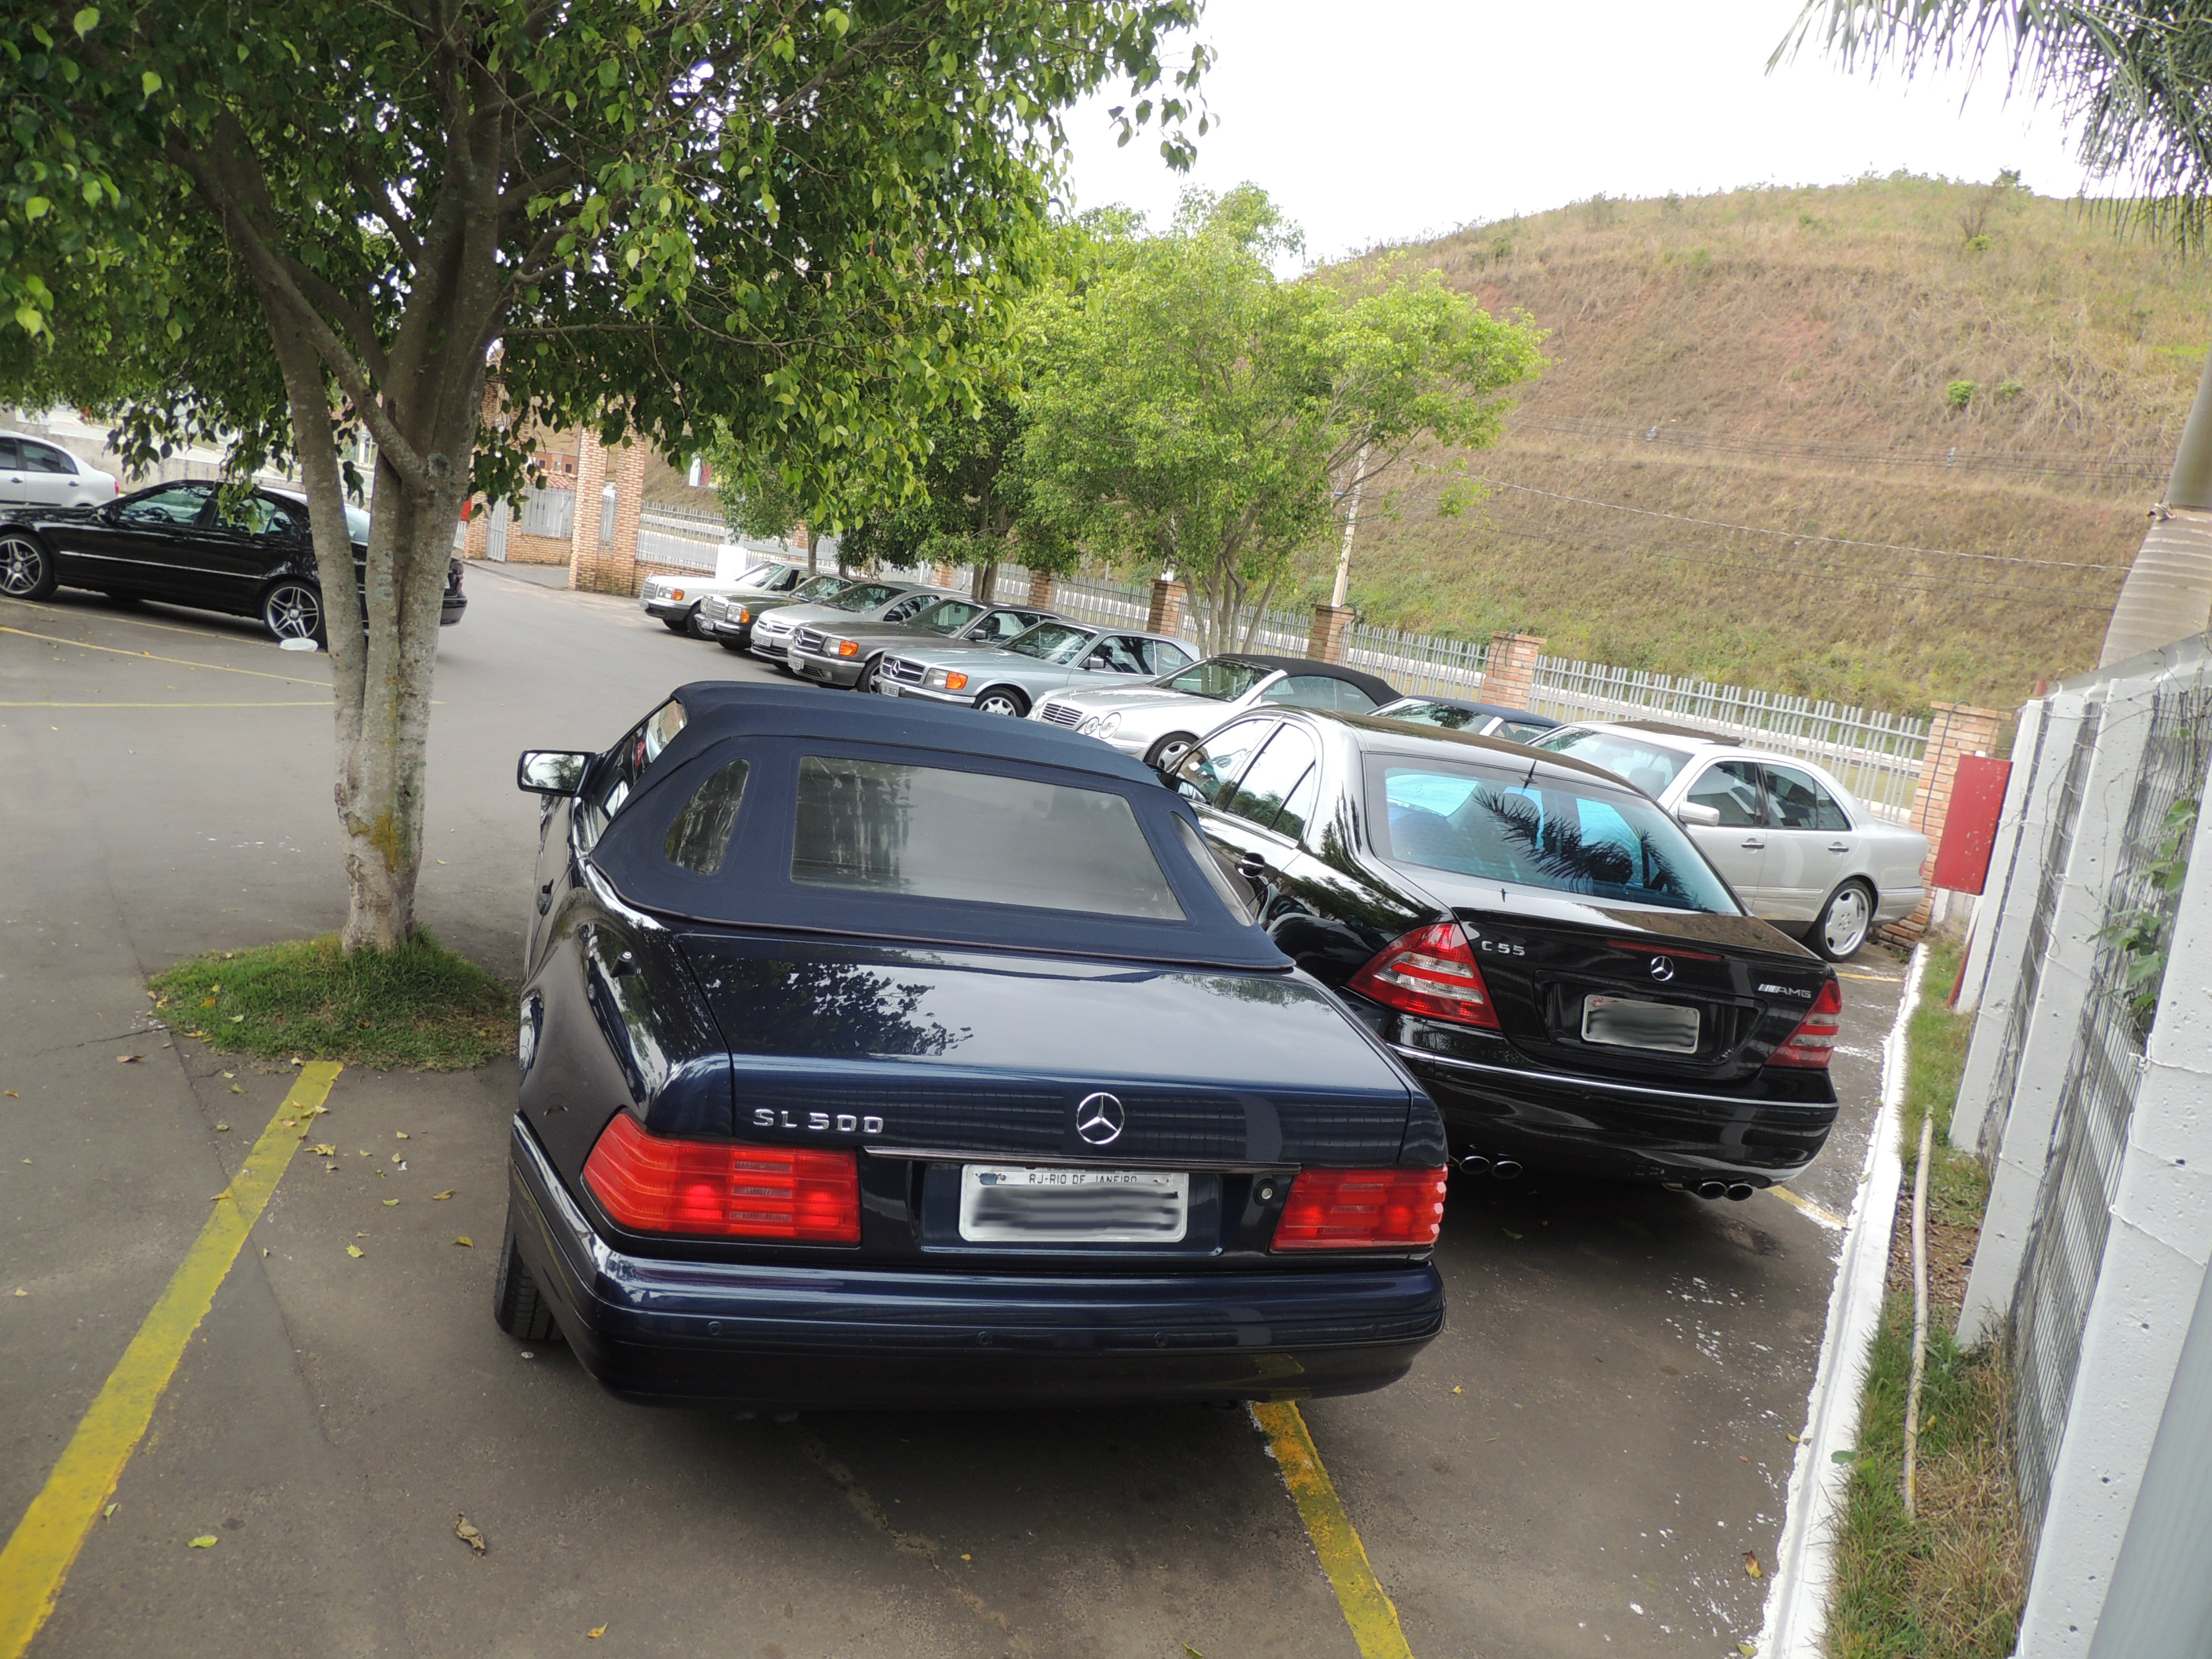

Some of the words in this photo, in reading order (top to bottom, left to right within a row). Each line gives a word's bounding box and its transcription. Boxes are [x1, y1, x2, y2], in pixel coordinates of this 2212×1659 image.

[1498, 942, 1525, 956] 55
[1775, 985, 1812, 999] AMG
[807, 1112, 884, 1134] 500
